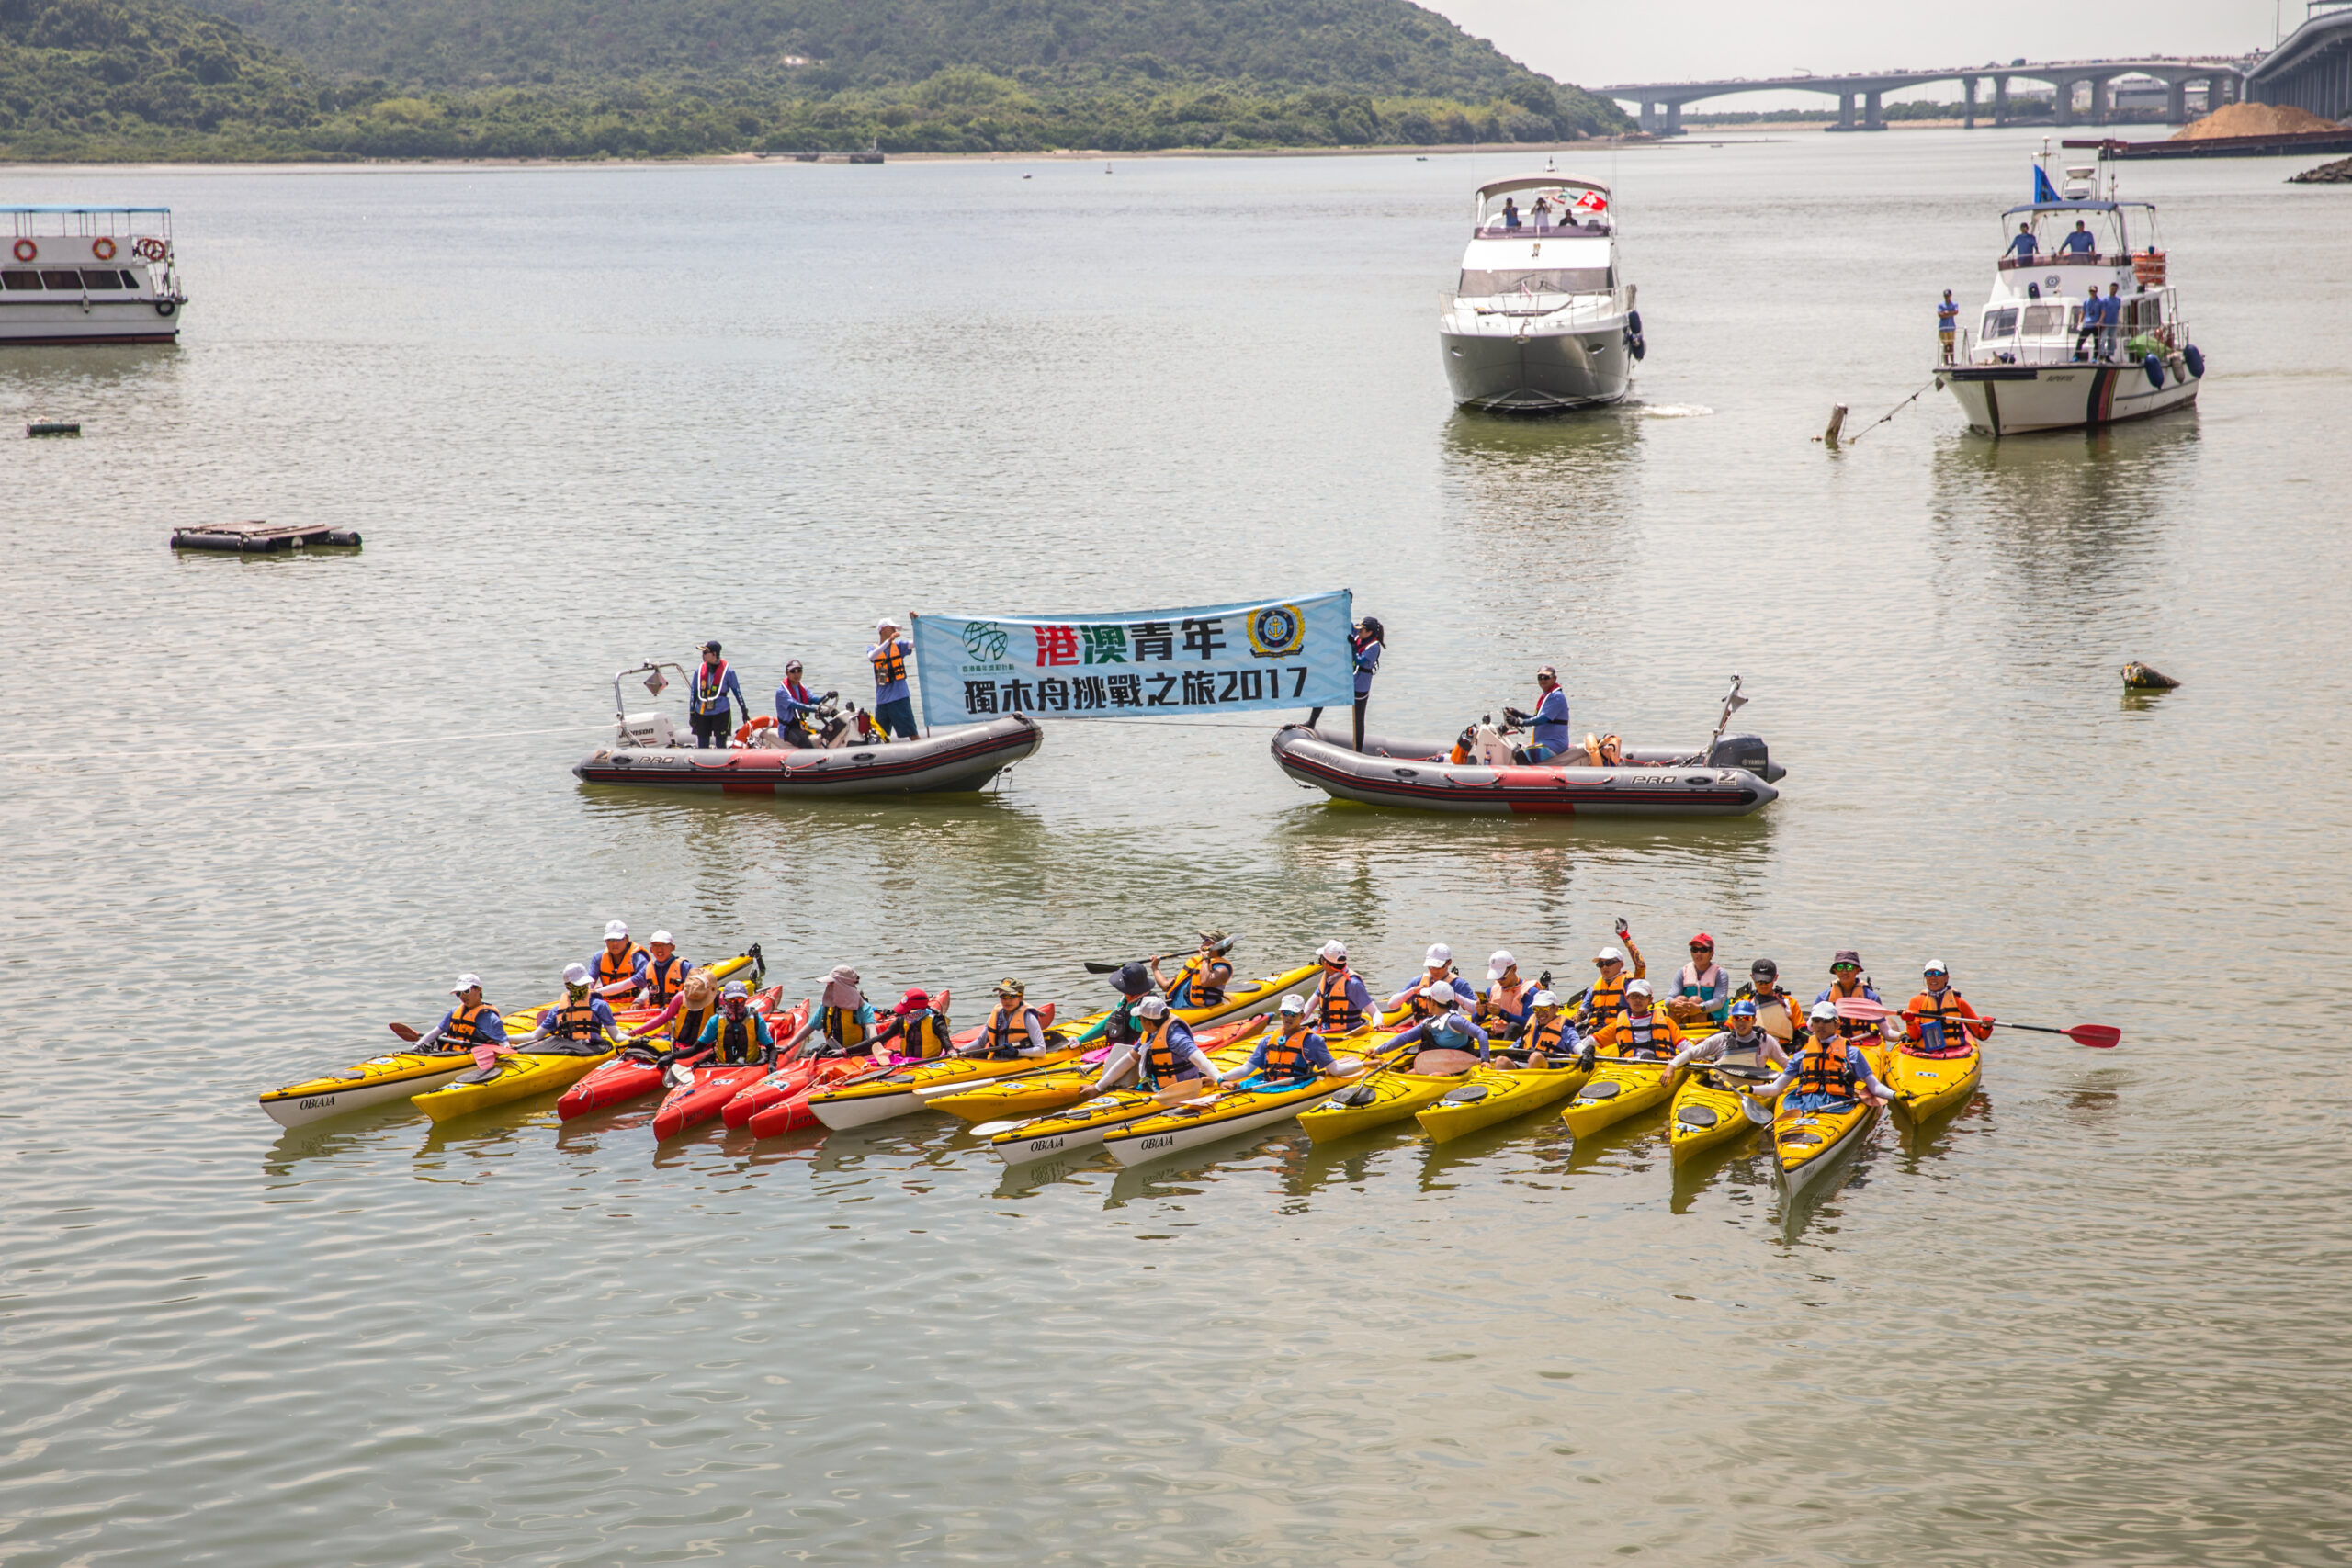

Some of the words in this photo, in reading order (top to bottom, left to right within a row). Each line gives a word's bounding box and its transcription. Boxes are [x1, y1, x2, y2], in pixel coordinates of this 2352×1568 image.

[1032, 618, 1227, 667] 港澳青年
[963, 666, 1308, 715] 獨木舟挑戰之旅2017
[638, 756, 675, 764] PRO
[1631, 775, 1678, 784] PRO
[300, 1095, 335, 1110] OB(A)A
[1030, 1136, 1064, 1152] OB(A)A
[1140, 1134, 1174, 1150] OB(A)A
